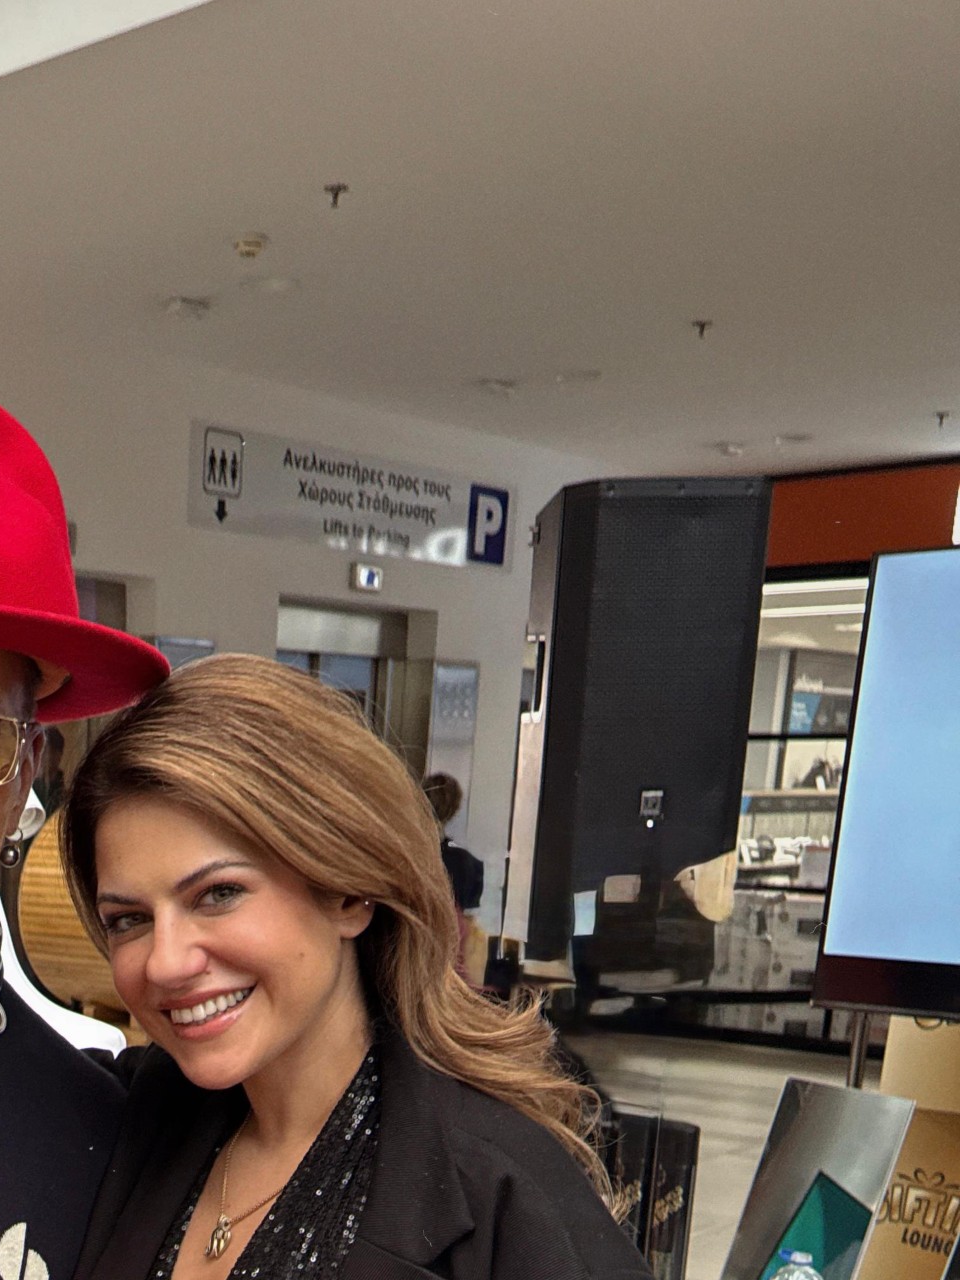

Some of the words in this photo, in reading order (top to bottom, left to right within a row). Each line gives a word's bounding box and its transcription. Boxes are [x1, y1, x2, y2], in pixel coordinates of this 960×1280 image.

[283, 448, 385, 490] Ανελκυστήρες
[388, 472, 419, 497] προς
[423, 479, 452, 501] τους
[297, 479, 354, 511] Χώρους
[358, 490, 437, 526] Στάθμευσης
[323, 517, 349, 536] Lifts
[474, 493, 503, 555] P
